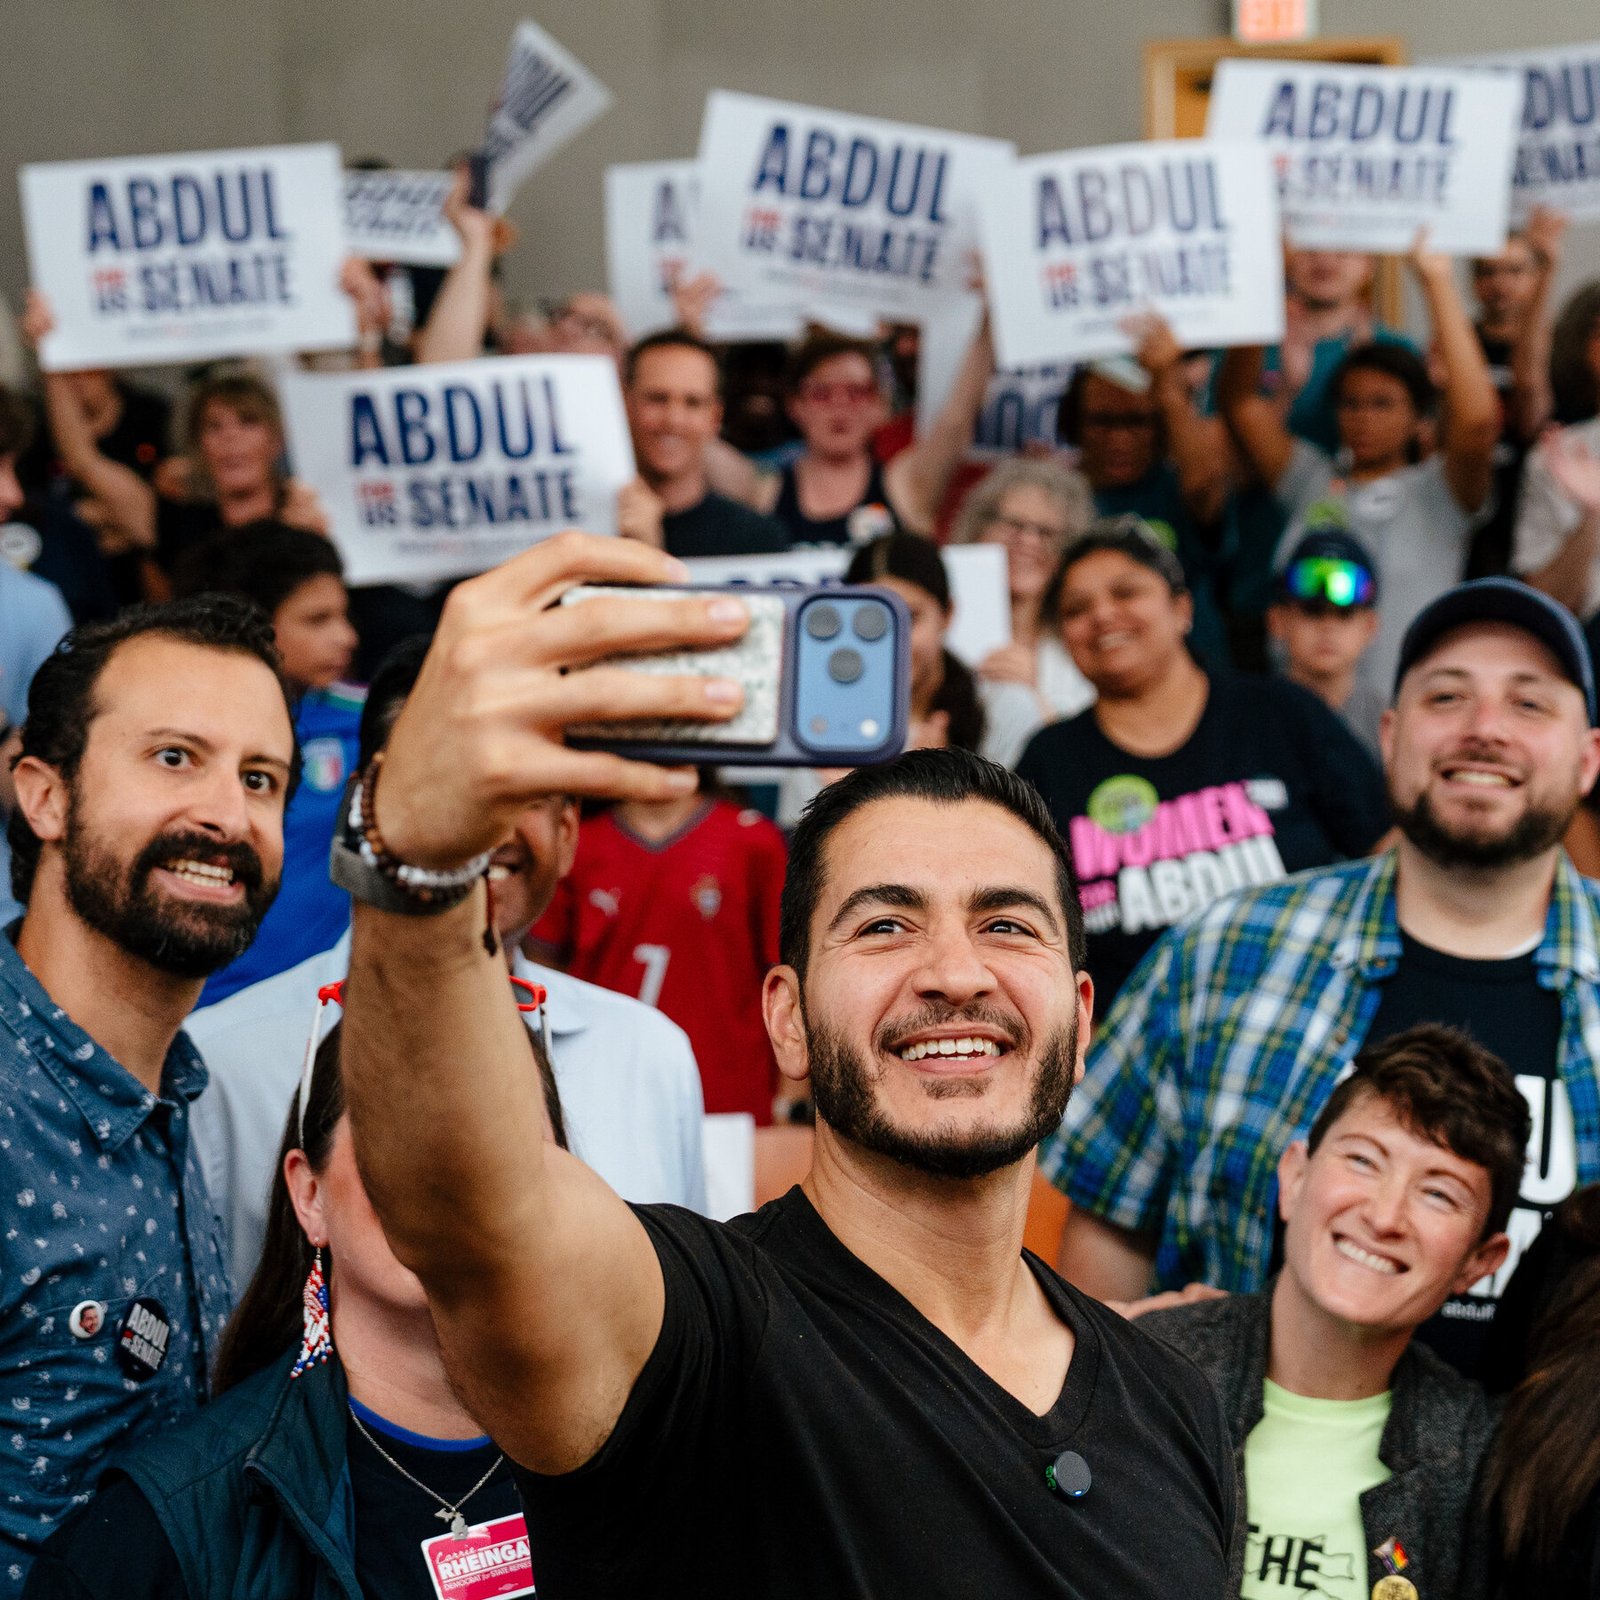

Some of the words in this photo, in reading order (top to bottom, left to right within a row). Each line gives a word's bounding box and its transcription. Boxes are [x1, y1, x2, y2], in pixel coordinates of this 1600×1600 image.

[1263, 80, 1458, 146] ABDUL
[753, 122, 949, 224] ABDUL
[1304, 153, 1452, 207] SENATE
[86, 165, 292, 255] ABDUL
[1038, 159, 1230, 250] ABDUL
[790, 212, 941, 284] SENATE
[140, 254, 293, 313] SENATE
[348, 374, 577, 467] ABDUL
[409, 470, 579, 528] SENATE
[126, 1303, 170, 1353] ABDUL
[437, 1539, 531, 1580] RHEINGA
[490, 1566, 510, 1578] STATE
